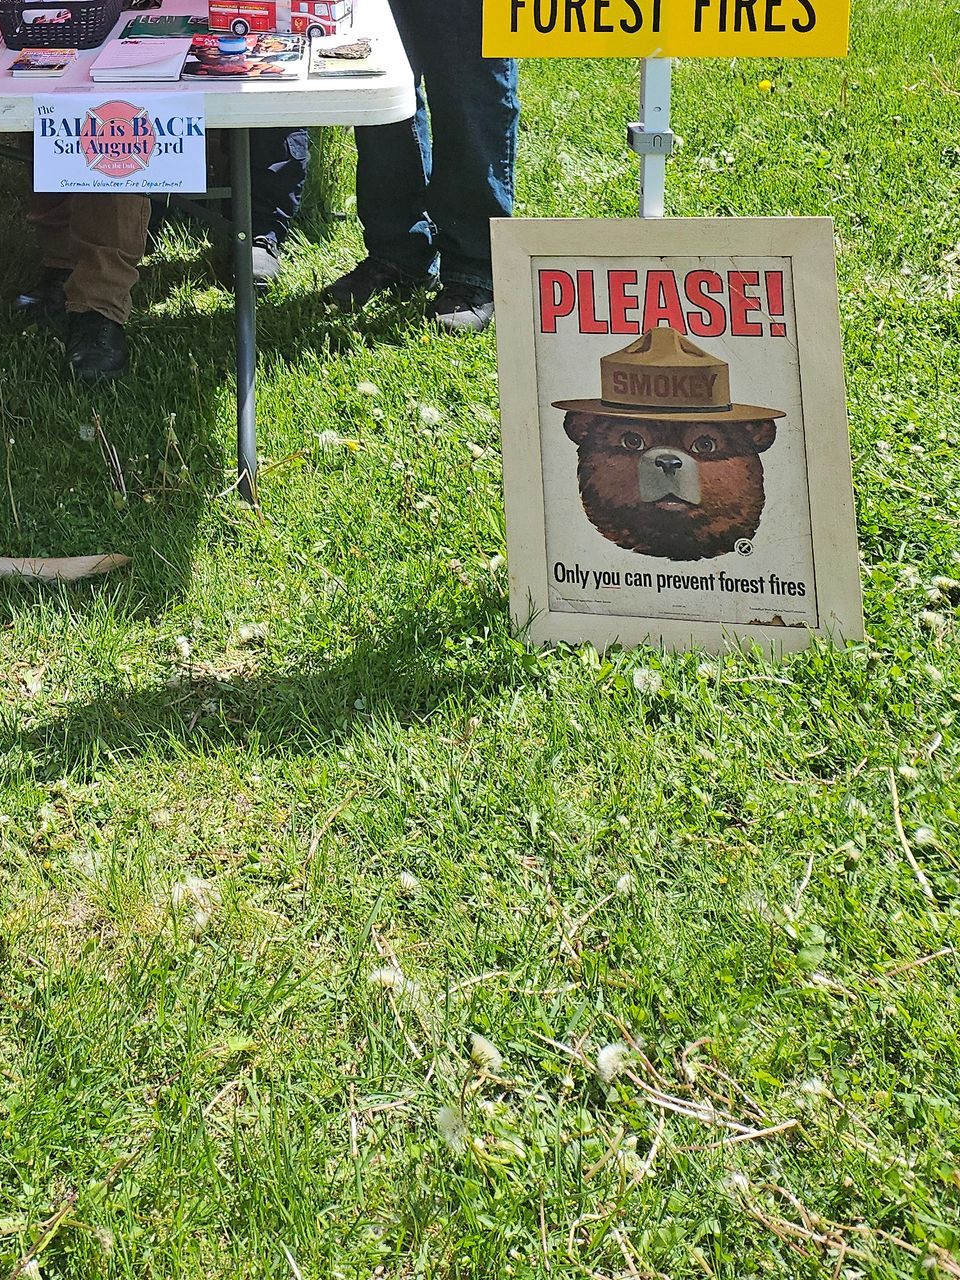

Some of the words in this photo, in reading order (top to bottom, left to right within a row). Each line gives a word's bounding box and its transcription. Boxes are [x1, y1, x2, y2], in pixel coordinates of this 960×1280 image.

[38, 105, 55, 116] The
[40, 117, 105, 137] BALL
[110, 120, 125, 137] is
[132, 116, 205, 137] BACK
[53, 138, 81, 155] Sat
[84, 139, 149, 157] August
[153, 137, 184, 156] 3rd
[60, 179, 90, 188] Sherman
[93, 179, 123, 188] Volunteer
[125, 179, 139, 188] Fire
[142, 179, 183, 188] Department
[538, 267, 787, 338] PLEASE!
[612, 369, 718, 400] SMOKEY
[554, 561, 590, 590] Only
[593, 570, 620, 590] you
[625, 572, 652, 588] can
[656, 572, 715, 593] prevent
[718, 570, 765, 595] forest
[769, 573, 806, 597] fires
